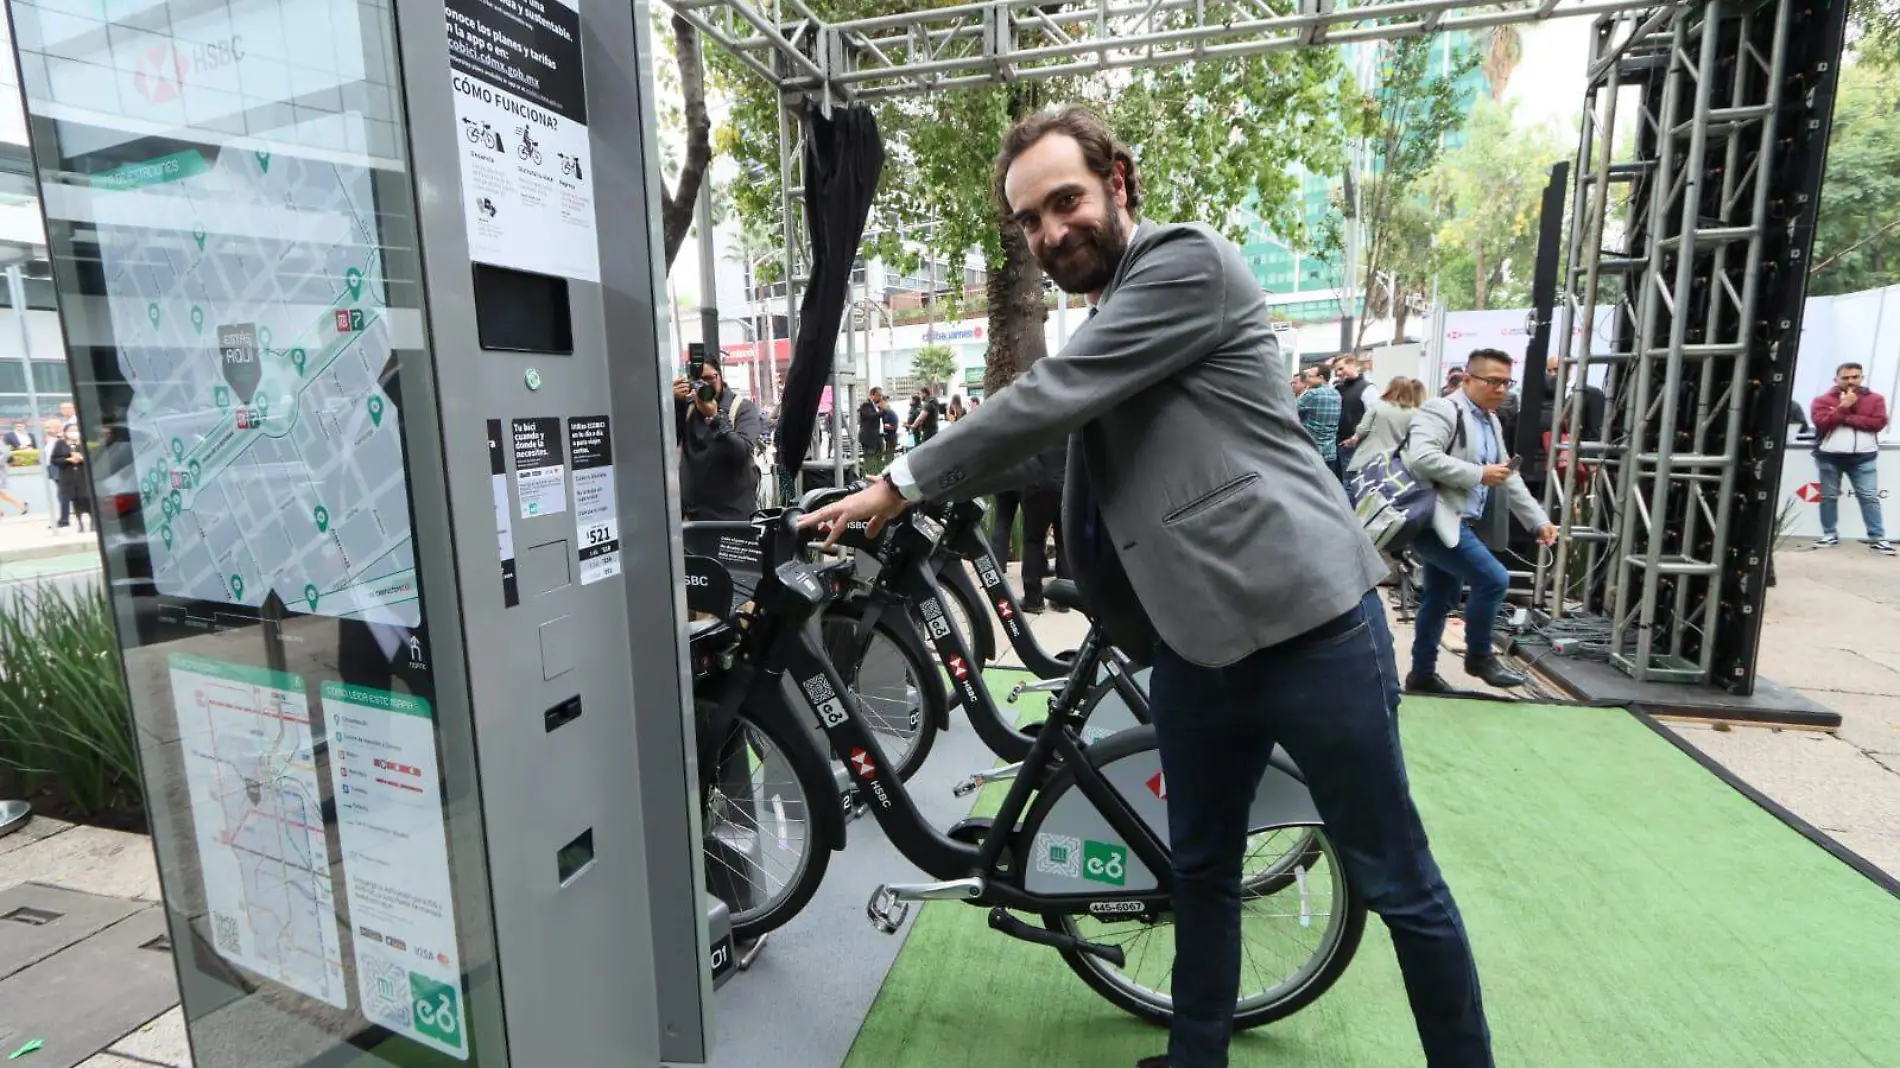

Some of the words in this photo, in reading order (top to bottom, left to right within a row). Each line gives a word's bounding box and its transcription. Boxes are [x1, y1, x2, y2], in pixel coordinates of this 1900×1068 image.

[517, 4, 524, 15] y
[524, 8, 574, 43] sustentable.
[454, 23, 465, 38] la
[466, 32, 486, 50] app
[486, 42, 494, 52] o
[494, 46, 510, 60] en:
[476, 19, 491, 37] los
[492, 30, 523, 53] planes
[523, 46, 530, 58] y
[530, 48, 557, 70] tarifas
[192, 34, 246, 74] HSBC
[453, 76, 492, 103] CÓMO
[494, 94, 559, 131] FUNCIONA?
[513, 423, 523, 432] Tu
[514, 432, 539, 441] cuando
[515, 440, 537, 449] donde
[537, 439, 544, 447] la
[516, 449, 549, 458] necesites.
[847, 521, 869, 529] SBC
[962, 680, 977, 703] HSBC
[870, 780, 892, 810] HSBC
[711, 945, 727, 969] 01
